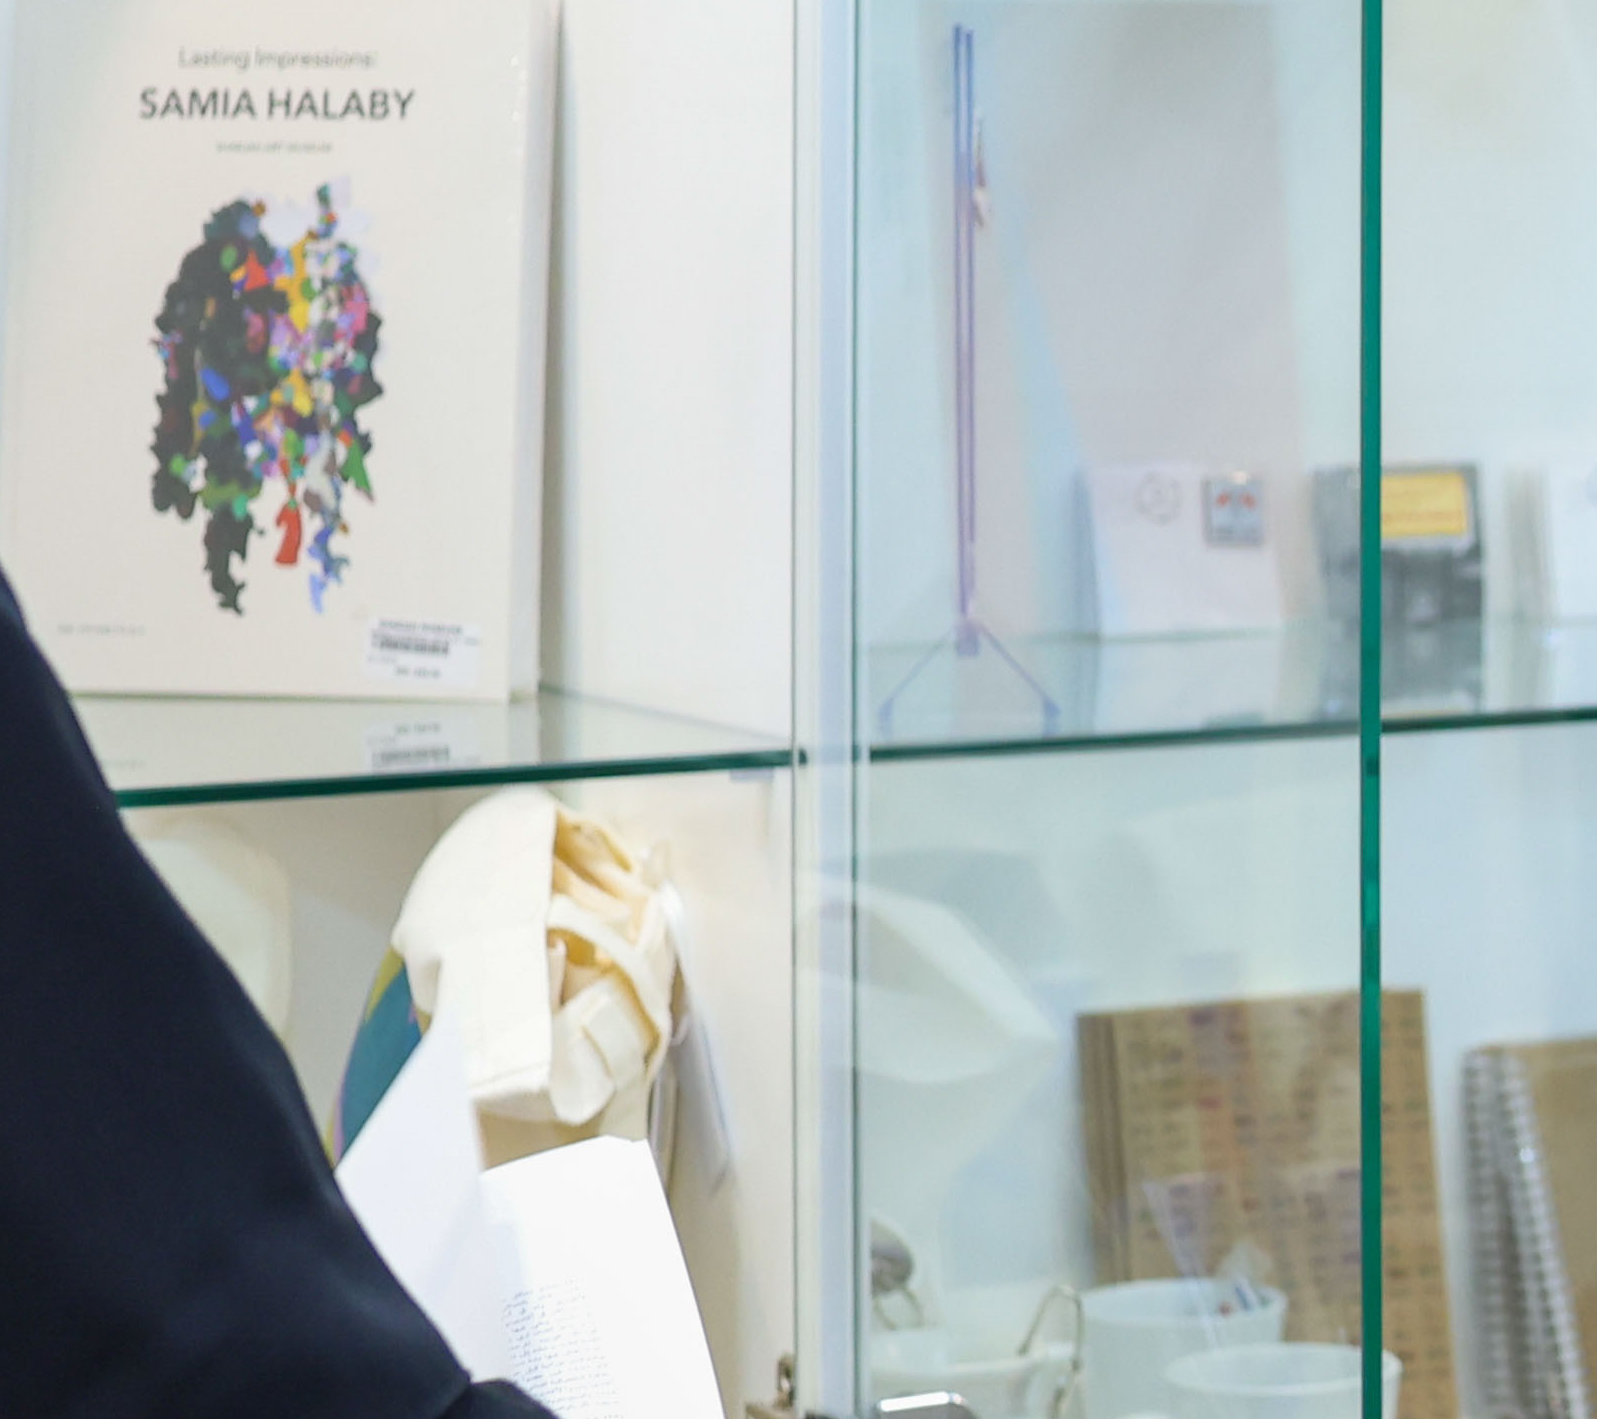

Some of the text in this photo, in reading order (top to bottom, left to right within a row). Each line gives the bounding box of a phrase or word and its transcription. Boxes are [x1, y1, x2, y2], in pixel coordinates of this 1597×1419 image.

[178, 47, 250, 71] Lasting
[140, 88, 415, 120] SAMIA HALABY
